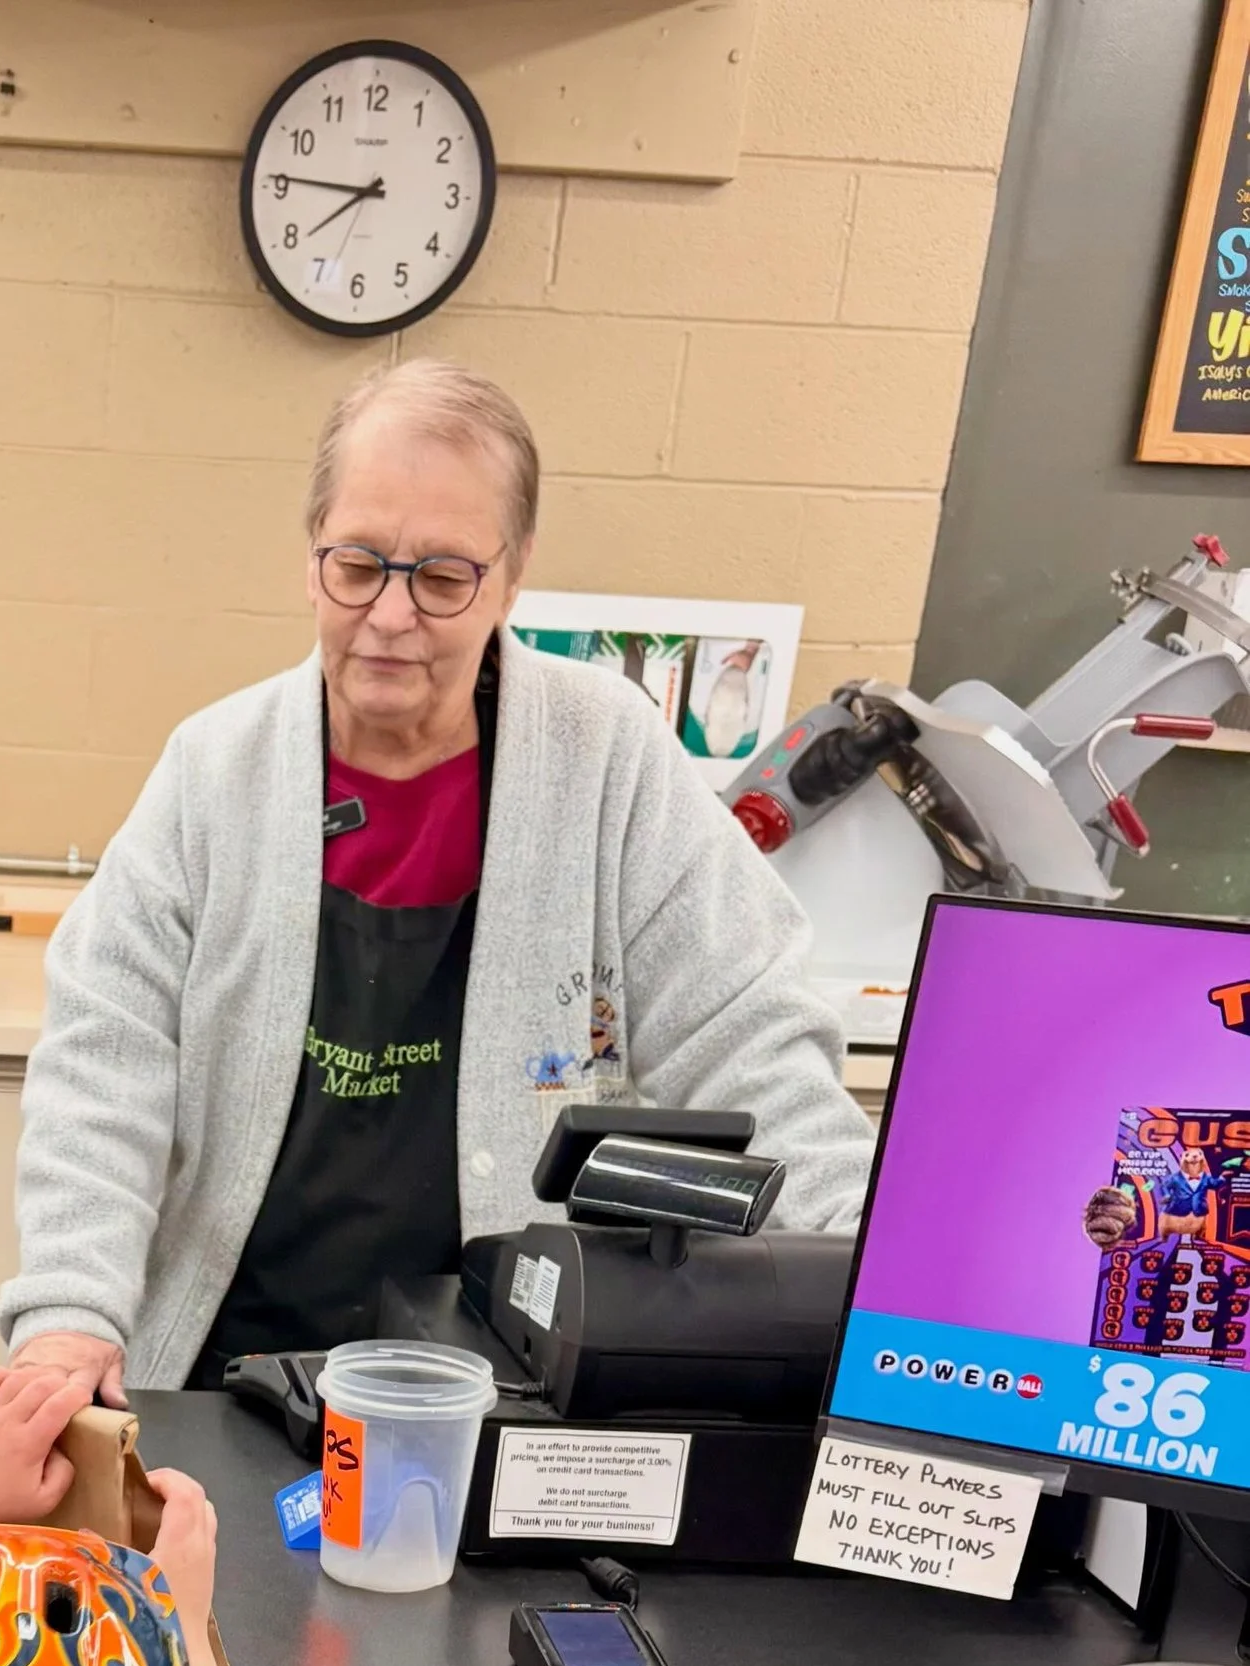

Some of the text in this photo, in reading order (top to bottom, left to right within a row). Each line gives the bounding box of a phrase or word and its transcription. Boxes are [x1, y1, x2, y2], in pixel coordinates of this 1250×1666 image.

[323, 96, 344, 123] 11
[363, 85, 389, 112] 12
[413, 101, 424, 128] 1
[290, 129, 315, 156] 10
[435, 137, 452, 164] 2
[274, 173, 289, 200] 9
[444, 183, 460, 210] 3
[283, 223, 299, 250] 8
[425, 231, 440, 257] 4
[313, 258, 326, 283] 7
[394, 263, 409, 288] 5
[350, 273, 366, 299] 6
[320, 1066, 401, 1098] Market
[877, 1353, 1043, 1396] POWER BALL
[326, 1429, 359, 1470] PS
[548, 1443, 570, 1452] effort
[582, 1444, 612, 1455] provide
[614, 1445, 661, 1455] competitive
[557, 1455, 586, 1465] impose
[595, 1457, 635, 1467] surcharge
[1057, 1421, 1219, 1477] MILLION
[549, 1466, 572, 1475] credit
[573, 1467, 592, 1475] card
[594, 1467, 645, 1477] transactions.
[825, 1445, 1003, 1500] LOTTERY PLAYERS
[538, 1498, 631, 1510] debit card transactions.
[546, 1487, 627, 1499] We do not surcharge
[816, 1478, 1017, 1534] MUST FILL OUT SLIPS
[511, 1516, 655, 1532] Thank you for your business!
[829, 1510, 996, 1561] NO EXCEPTIONS
[839, 1541, 903, 1570] THANK
